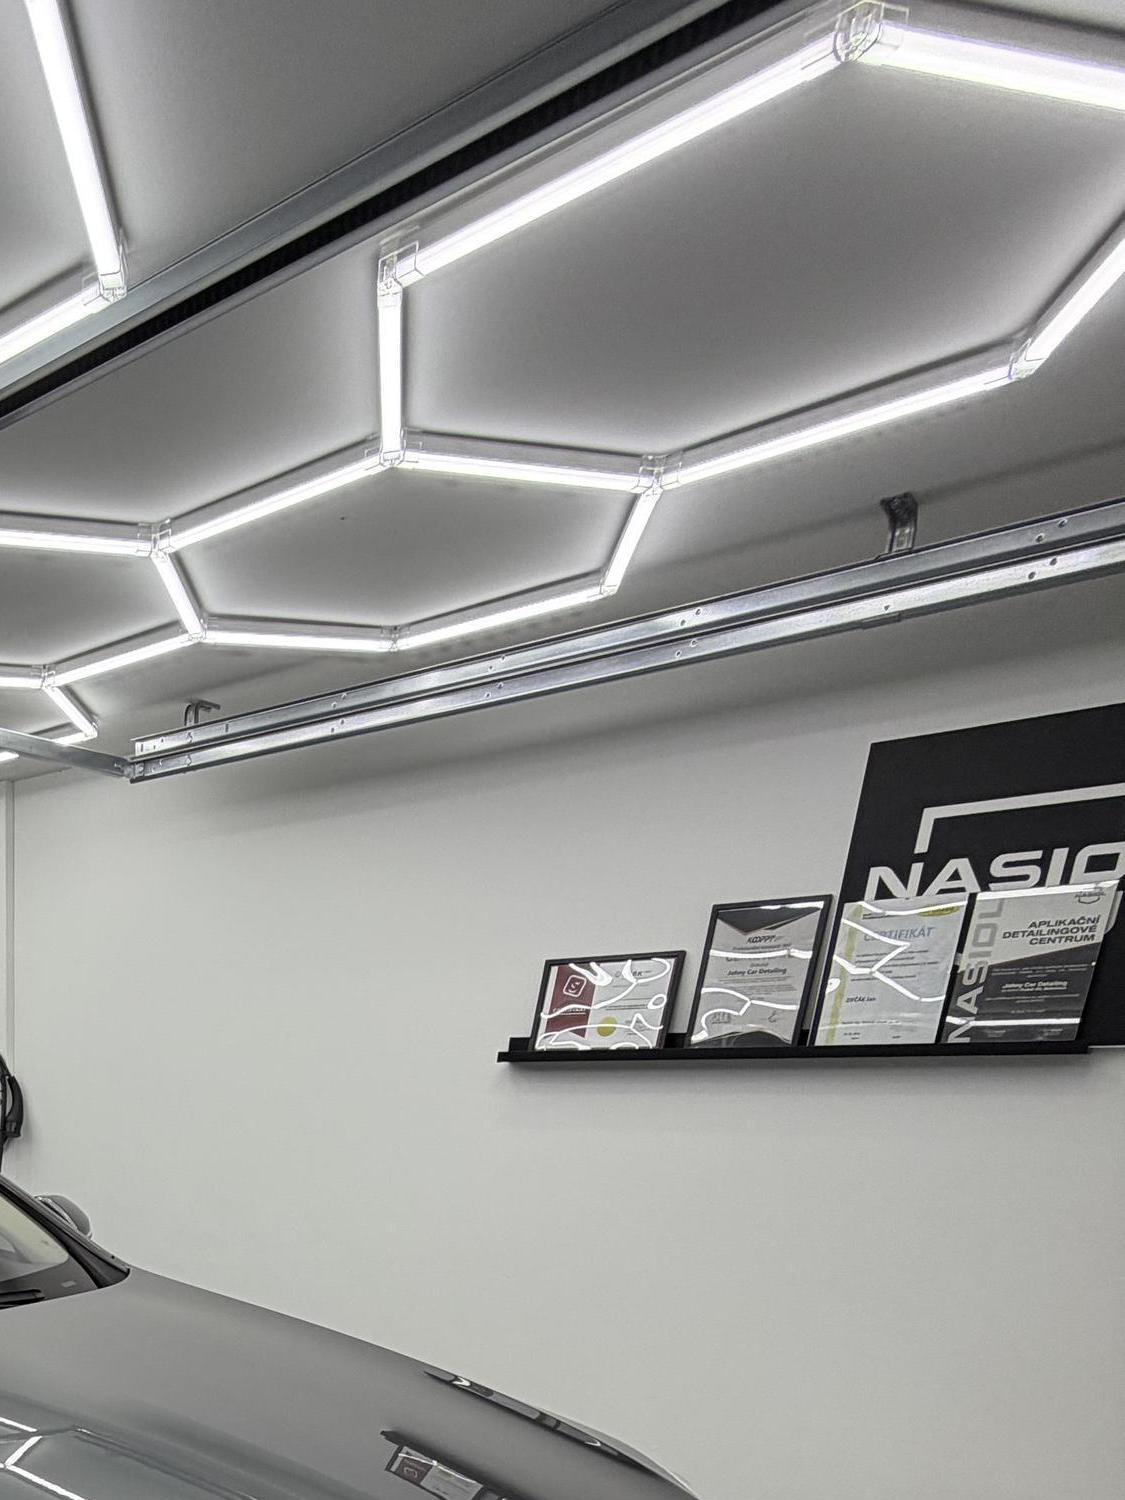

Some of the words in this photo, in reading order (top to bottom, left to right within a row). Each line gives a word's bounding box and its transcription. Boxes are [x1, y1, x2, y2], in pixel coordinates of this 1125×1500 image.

[1028, 914, 1101, 929] APLIKAČNÍ
[864, 925, 935, 942] CRTIFIKÁT
[1002, 924, 1097, 939] DETAILINGOVÉ
[1028, 934, 1095, 946] CENTRUM
